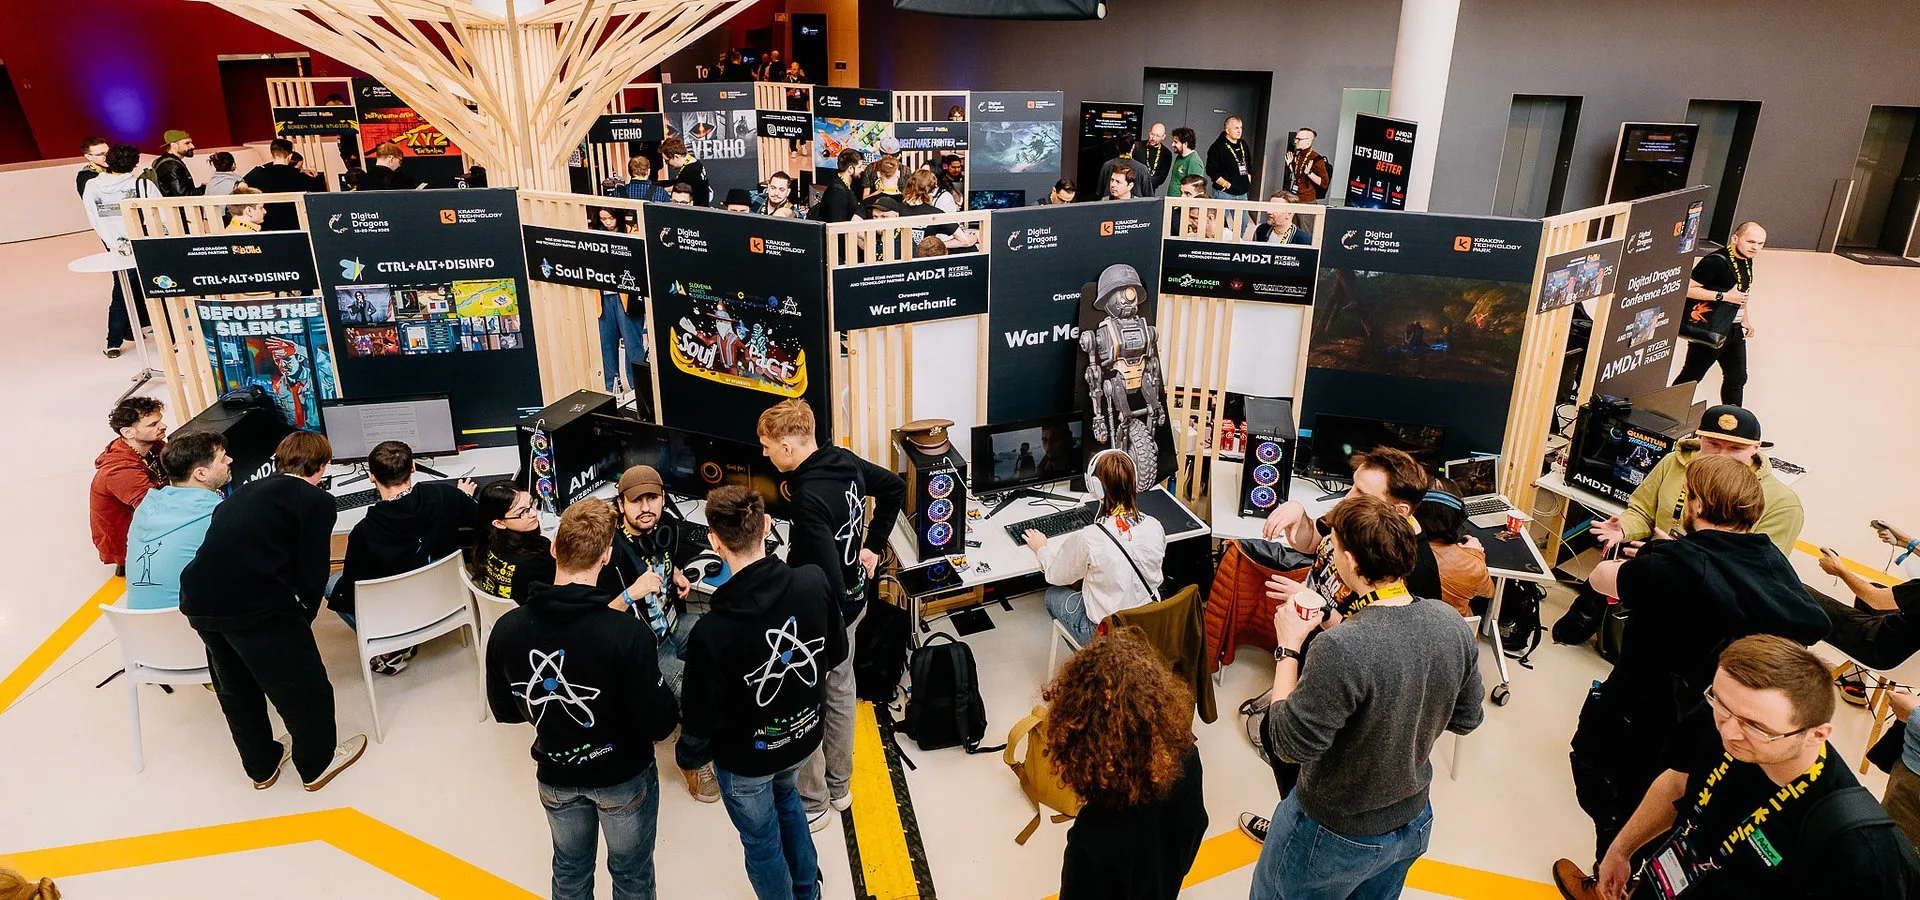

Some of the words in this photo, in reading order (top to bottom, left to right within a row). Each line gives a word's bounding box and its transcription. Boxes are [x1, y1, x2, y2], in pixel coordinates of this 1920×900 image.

[611, 128, 641, 140] VERHO
[777, 126, 802, 134] REVULO
[407, 133, 447, 147] XYZ
[692, 138, 746, 159] VERHO
[1355, 145, 1372, 158] LET'S
[1372, 149, 1394, 163] BUILD
[1376, 161, 1403, 175] BETTER
[351, 212, 379, 221] Digital
[352, 219, 389, 228] Dragons
[678, 228, 700, 238] Digital
[1027, 227, 1051, 236] Digital
[1115, 222, 1151, 230] TECHNOLOGY
[678, 236, 707, 247] Dragons
[1027, 235, 1058, 244] Dragons
[1365, 230, 1393, 240] Digital
[578, 241, 600, 251] AMD
[765, 244, 806, 254] TECHNOLOGY
[1364, 238, 1400, 248] Dragons
[1232, 253, 1260, 263] AMD
[377, 258, 495, 273] CTRL+ALT+DISINFO
[193, 271, 300, 286] CTRL+ALT+DISINFO
[555, 264, 582, 280] Soul
[586, 268, 616, 284] Pact
[906, 271, 935, 282] AMD
[1628, 272, 1651, 292] Digital
[1651, 266, 1681, 284] Dragons
[689, 282, 712, 291] SLOVENIA
[898, 291, 930, 299] Chronospace
[1053, 292, 1081, 301] Chrono
[1621, 286, 1661, 309] Conference
[1661, 279, 1681, 296] 2025
[199, 305, 277, 321] BEFORE
[277, 303, 319, 319] THE
[869, 304, 897, 316] War
[899, 297, 957, 313] Mechanic
[217, 320, 304, 337] SILENCE
[1005, 329, 1049, 349] War
[1053, 324, 1079, 342] Me
[1646, 339, 1669, 353] RYZEN
[678, 333, 717, 369] Soul
[750, 345, 795, 380] Pact
[1644, 349, 1670, 365] RADEON
[1600, 355, 1632, 382] AMD
[1627, 430, 1667, 449] QUANTUM
[1628, 437, 1663, 452] THRESHOLD
[1573, 473, 1601, 489] AMD
[570, 486, 592, 504] RYZEN
